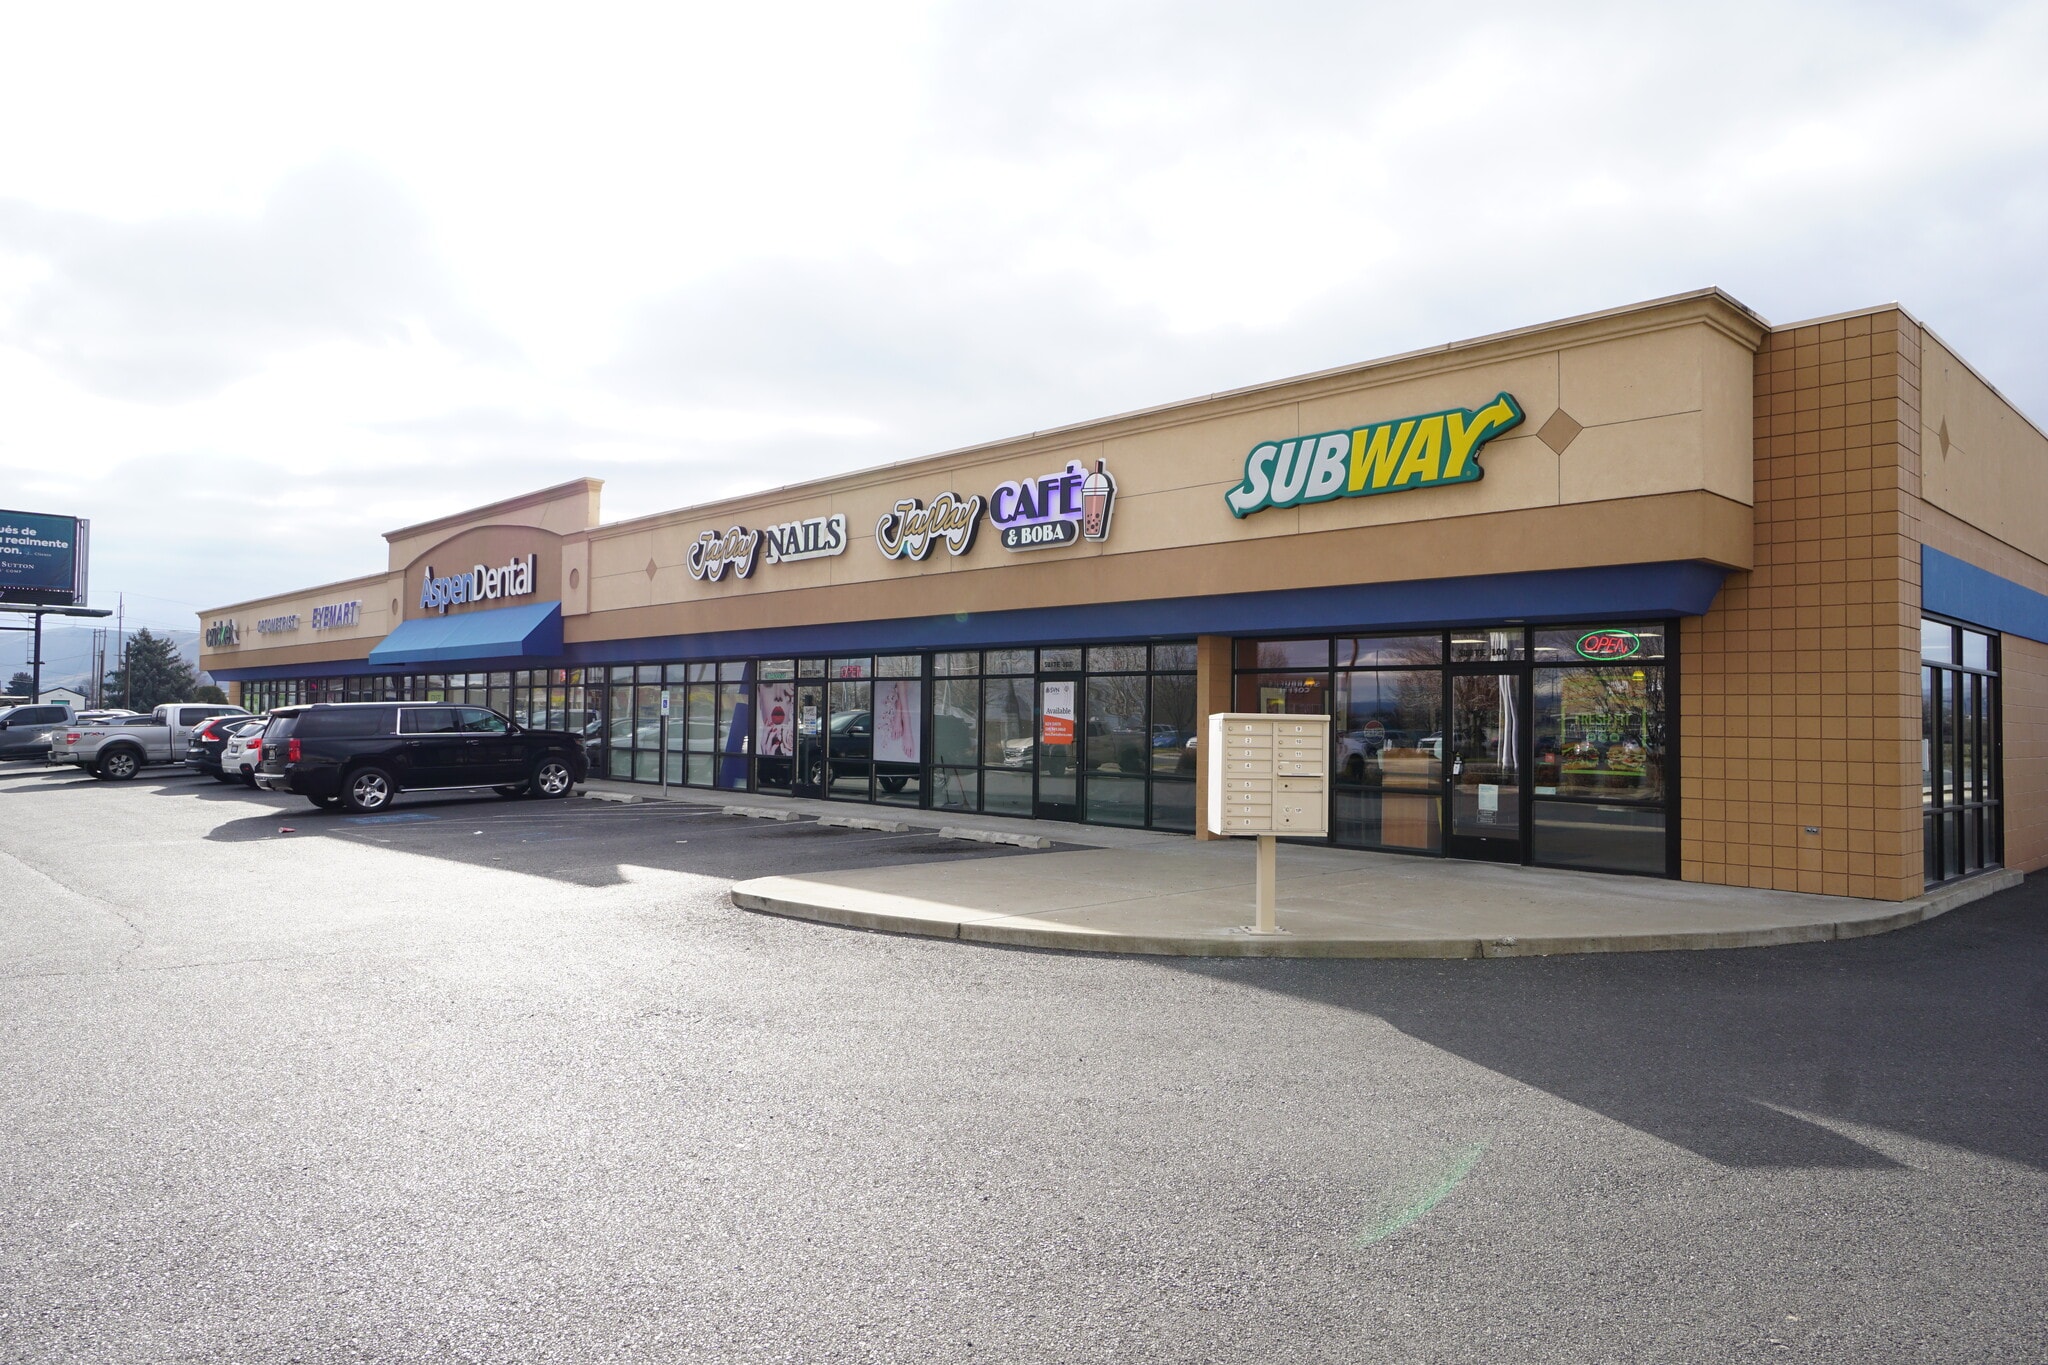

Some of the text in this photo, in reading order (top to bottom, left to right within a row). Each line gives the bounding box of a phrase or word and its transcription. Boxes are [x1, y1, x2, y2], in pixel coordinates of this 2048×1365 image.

[1228, 398, 1514, 513] SUBWAY
[990, 466, 1082, 524] CAFÉ
[21, 527, 37, 536] de
[877, 495, 977, 557] JayDay
[1007, 524, 1065, 545] & BOBA
[5, 537, 69, 549] realmente
[688, 518, 841, 579] JayDay NAILS
[420, 553, 533, 613] AspenDental
[257, 615, 298, 633] OPTOMETRIST
[312, 601, 358, 629] EYEMART
[205, 619, 238, 648] cricket
[1492, 648, 1507, 656] 100
[1584, 636, 1628, 654] OPEN
[841, 665, 862, 678] OPEN
[1046, 707, 1071, 715] Available
